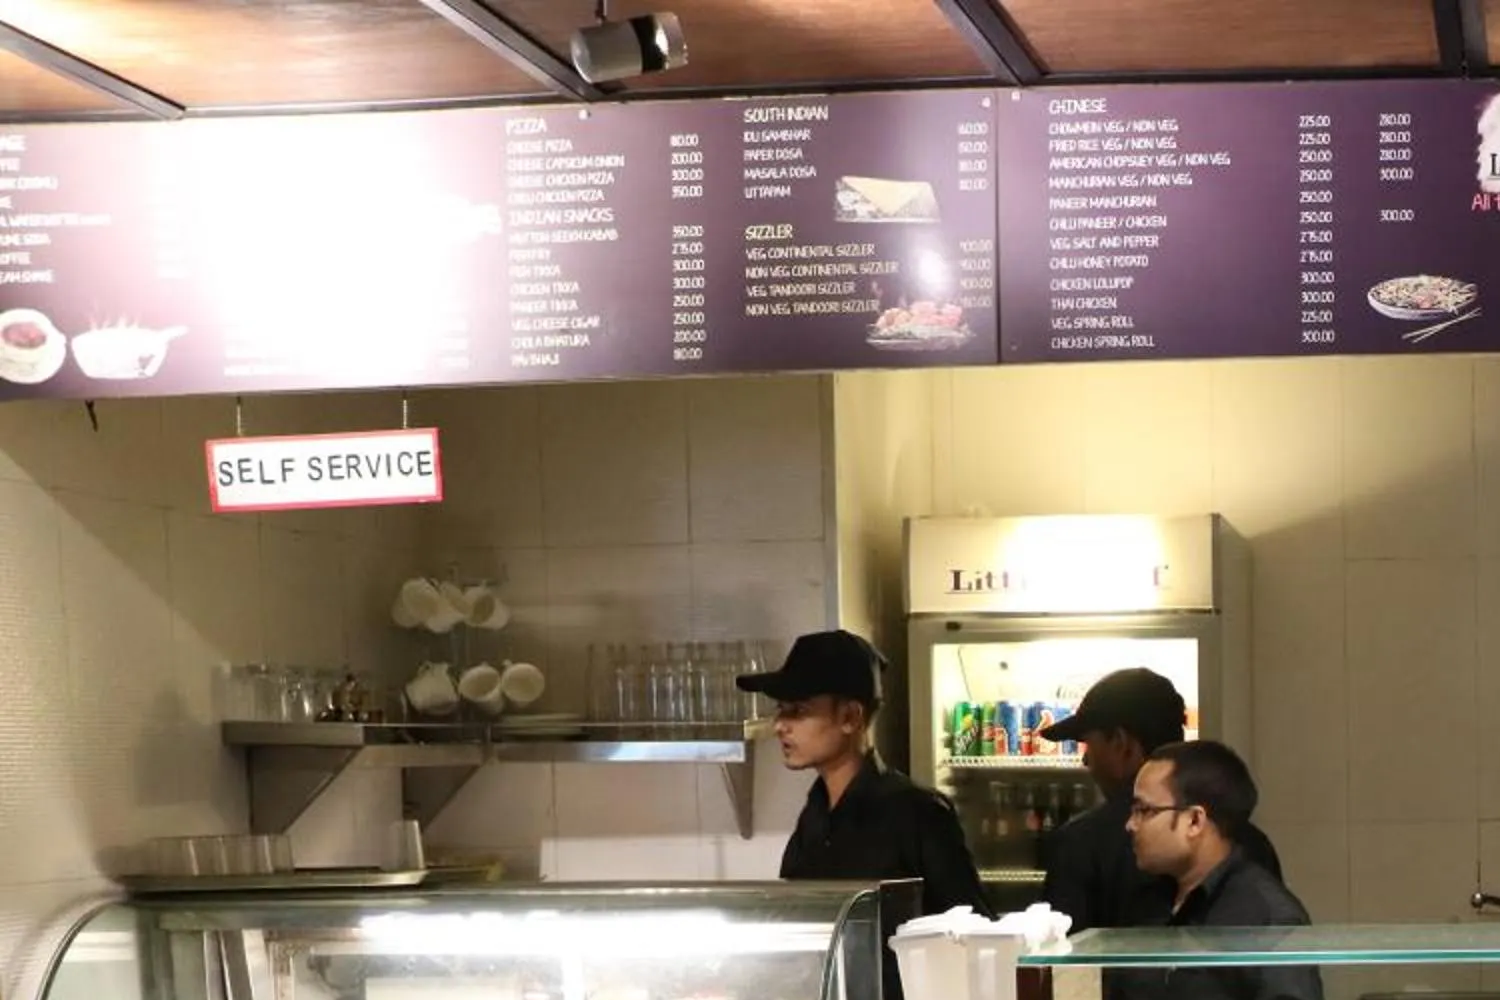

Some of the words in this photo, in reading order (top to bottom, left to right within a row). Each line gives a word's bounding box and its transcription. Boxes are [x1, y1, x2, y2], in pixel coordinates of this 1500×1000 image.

[743, 107, 785, 123] SOUTH
[1471, 194, 1490, 211] All
[218, 458, 294, 487] SELF
[307, 450, 433, 482] SERVICE
